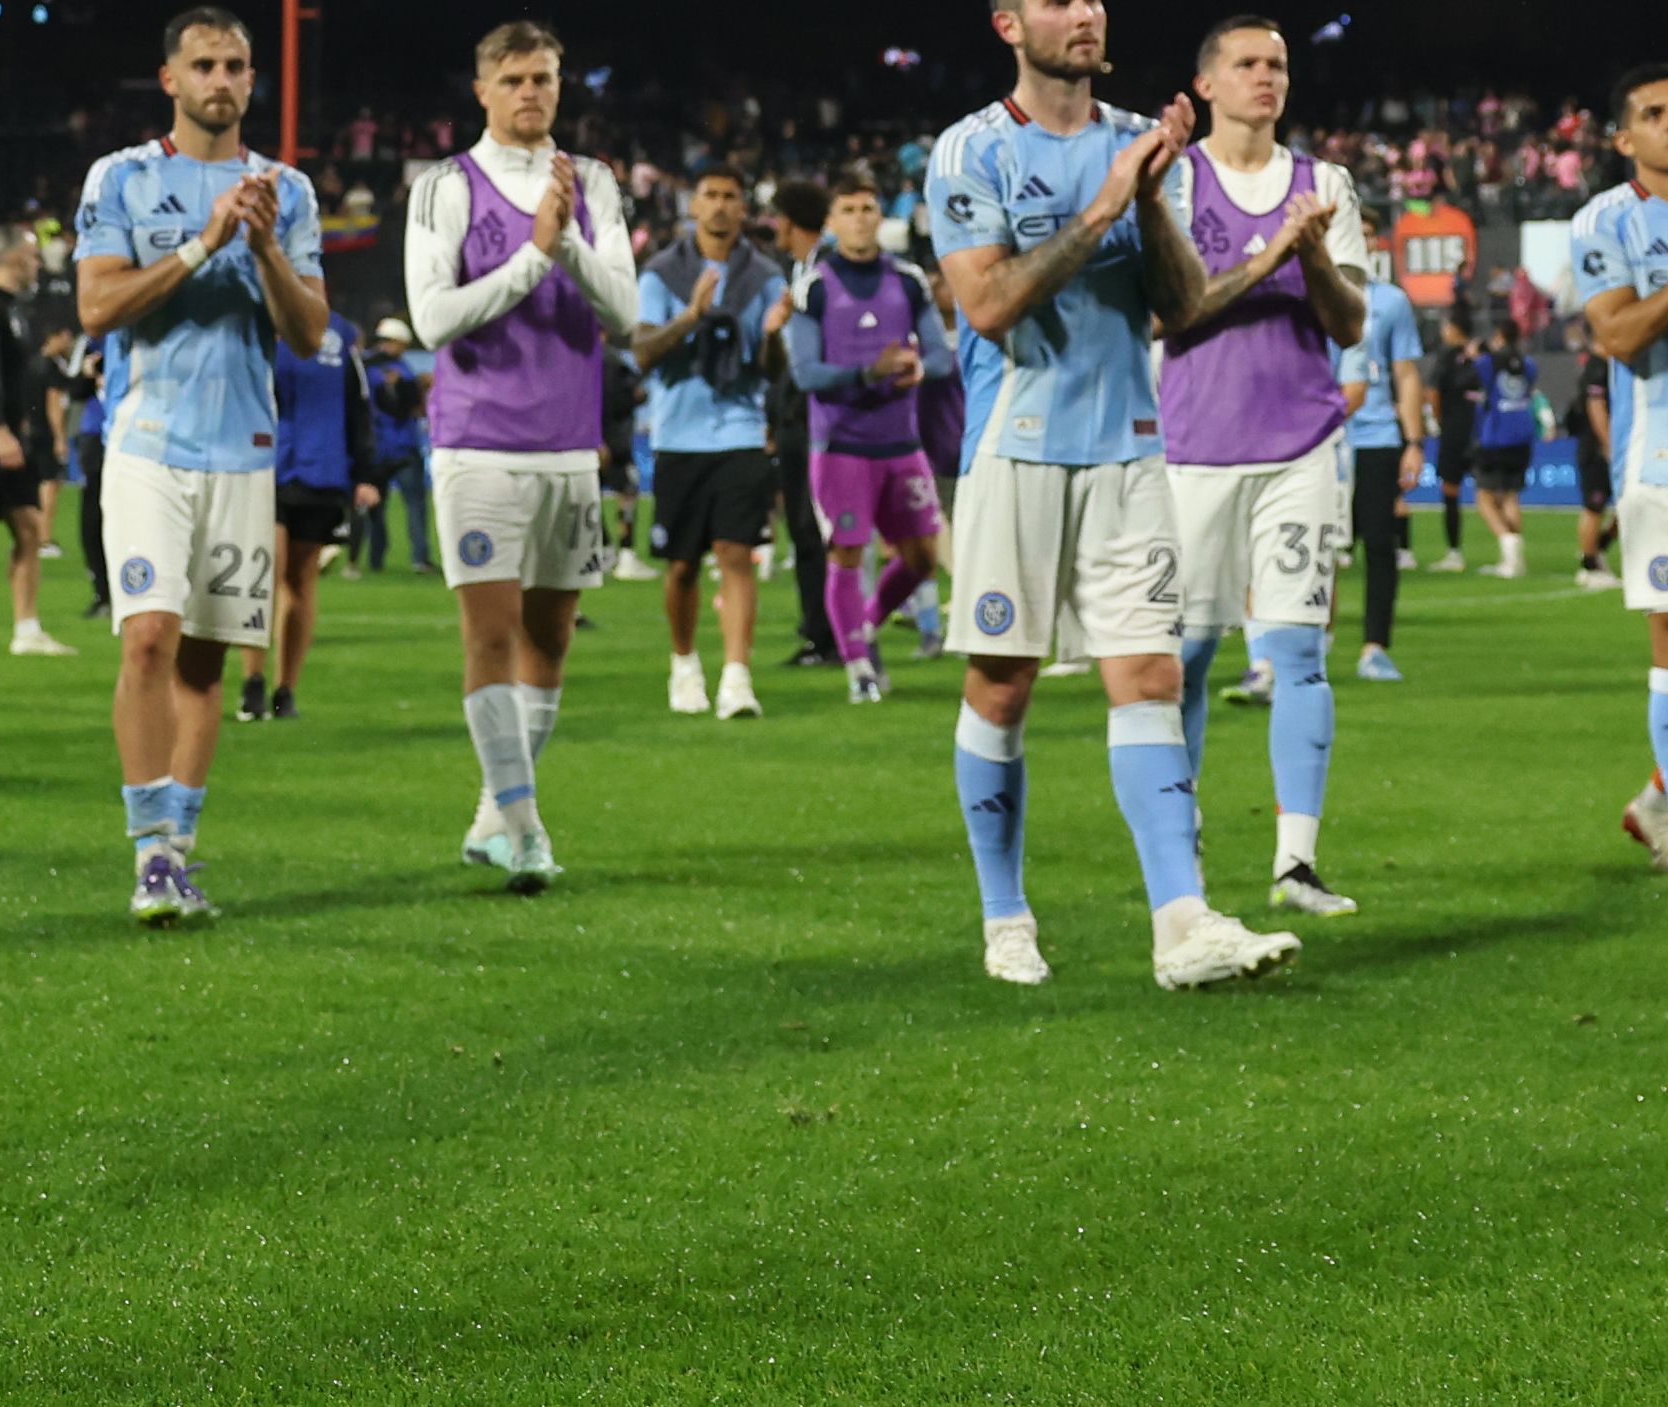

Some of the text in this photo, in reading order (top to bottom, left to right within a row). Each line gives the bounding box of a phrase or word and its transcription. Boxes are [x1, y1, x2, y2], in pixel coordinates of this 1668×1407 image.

[207, 543, 272, 601] 22
[1146, 545, 1179, 604] 2
[1275, 521, 1334, 576] 35
